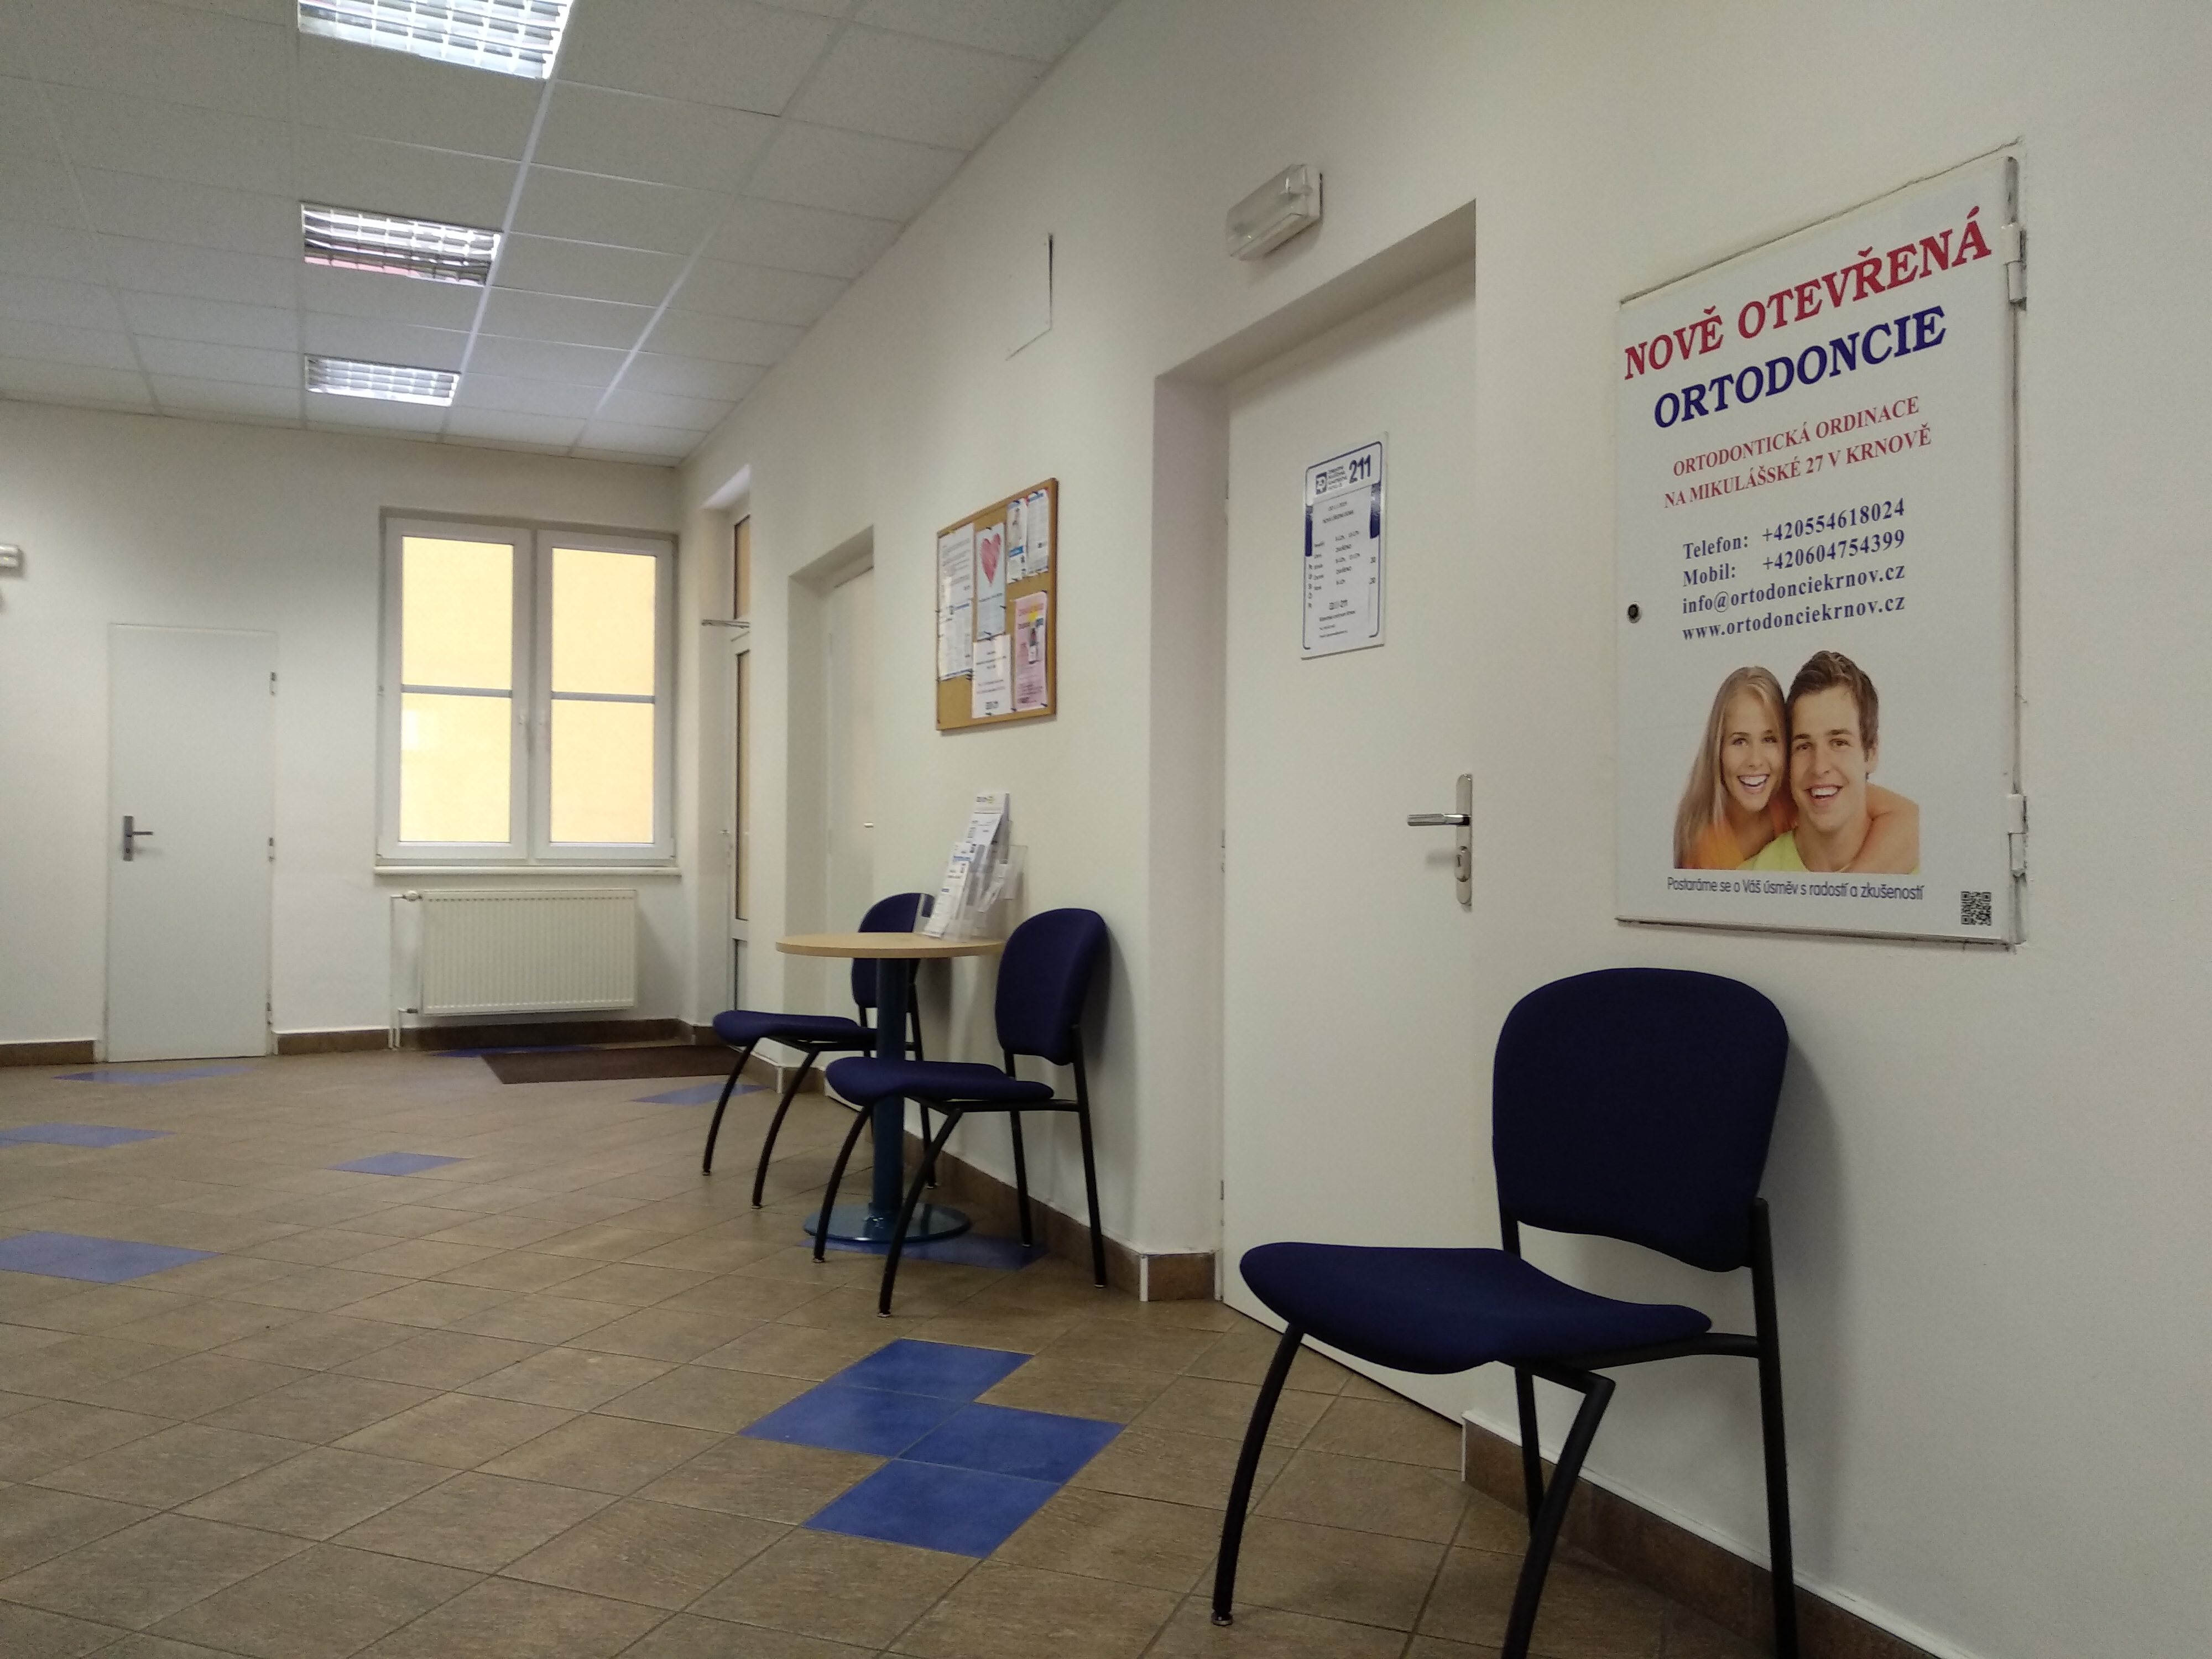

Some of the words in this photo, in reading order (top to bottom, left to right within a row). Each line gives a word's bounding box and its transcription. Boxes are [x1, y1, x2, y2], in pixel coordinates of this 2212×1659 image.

[1624, 306, 1725, 380] NOVĚ
[1738, 205, 1992, 339] OTEVŘENÁ
[1654, 305, 1947, 428] ORTODONCIE
[1664, 491, 1687, 509] NA
[1689, 456, 1801, 503] MIKULÁŠSKÉ
[1806, 455, 1824, 474] 27
[1828, 449, 1842, 468] V
[1846, 422, 1932, 465] KRNOVĚ
[1673, 422, 1811, 476] ORTODONTICKÁ
[1815, 395, 1920, 439] ORDINACE
[1349, 453, 1371, 483] 211
[1683, 535, 1749, 560] Telefon:
[1762, 498, 1905, 542] +420554618024
[1683, 563, 1736, 587] Mobil:
[1762, 529, 1905, 570] +420604754399
[1682, 565, 1906, 614] info@ortodonciekrnov.cz
[1682, 597, 1906, 640] www.ortodonciekrnov.cz
[1667, 877, 1718, 891] Postaráme
[1720, 881, 1731, 892] se
[1733, 880, 1741, 893] o
[1743, 878, 1761, 893] Váš
[1764, 879, 1798, 895] úsměv
[1800, 884, 1807, 895] s
[1809, 881, 1849, 897] radostí
[1850, 885, 1858, 897] a
[1860, 882, 1924, 900] zkušeností
